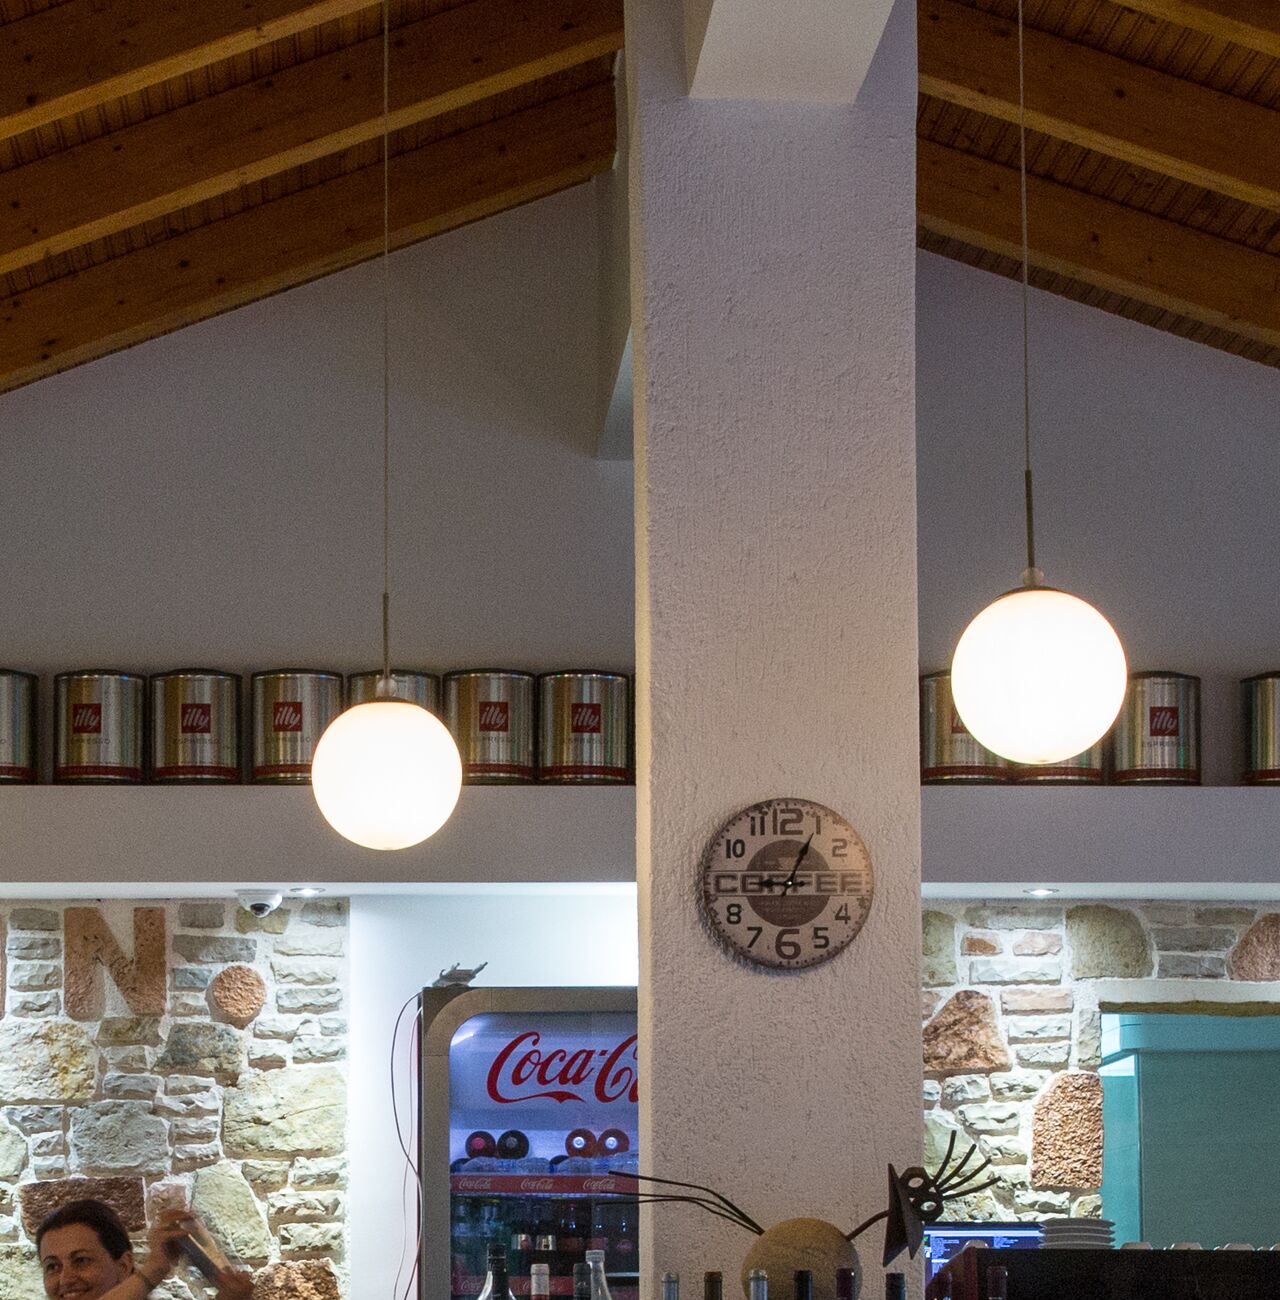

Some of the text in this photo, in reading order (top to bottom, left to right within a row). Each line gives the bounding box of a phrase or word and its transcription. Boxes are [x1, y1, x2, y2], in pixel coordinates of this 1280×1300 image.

[74, 708, 99, 729] illy
[182, 708, 209, 731] illy
[275, 706, 300, 729] illy
[481, 706, 506, 728] illy
[573, 708, 599, 730] illy
[1151, 711, 1177, 733] illy
[750, 815, 766, 836] 11
[772, 808, 804, 836] 12
[725, 839, 746, 859] 10
[831, 838, 848, 857] 2
[714, 873, 863, 894] COFFEE
[726, 903, 742, 925] 8
[834, 904, 851, 925] 4
[747, 926, 763, 949] 7
[774, 928, 802, 960] 6
[813, 926, 830, 949] 5
